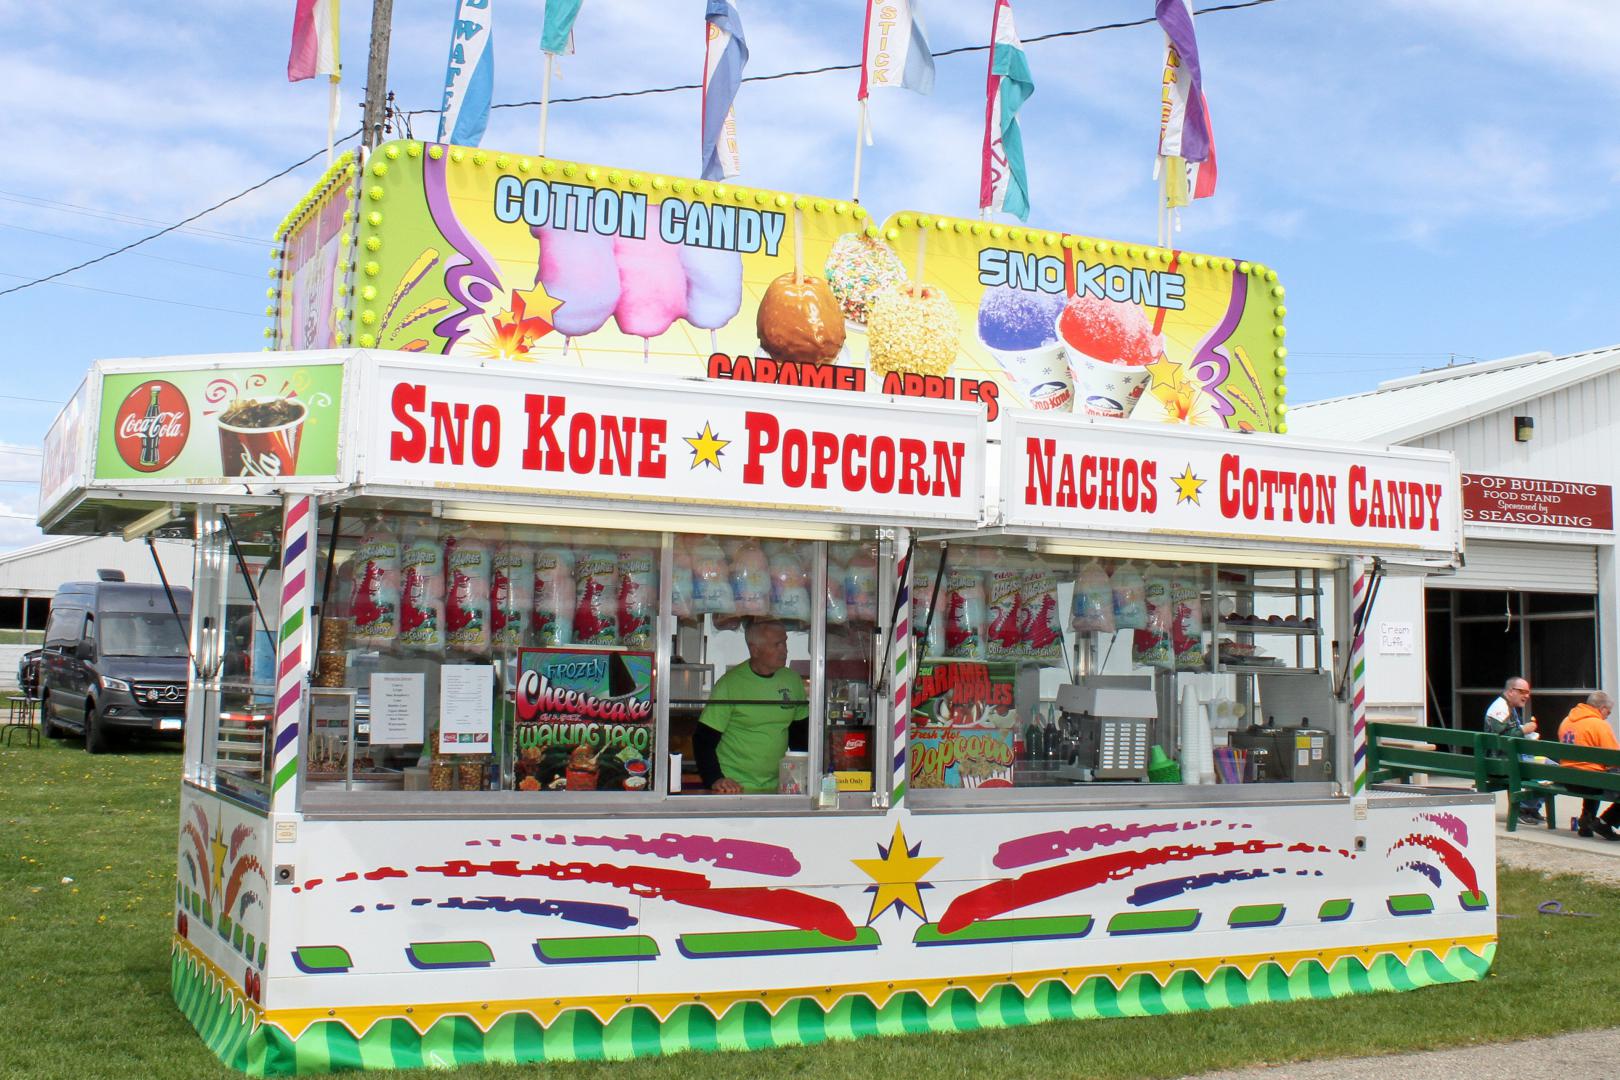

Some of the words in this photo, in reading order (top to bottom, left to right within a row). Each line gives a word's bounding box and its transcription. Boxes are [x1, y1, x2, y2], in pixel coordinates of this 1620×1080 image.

[494, 175, 648, 240] COTTON
[659, 198, 786, 257] CANDY
[978, 248, 1066, 294] SNO
[1076, 263, 1186, 310] KONE
[1483, 490, 1518, 500] FOOD
[1520, 493, 1561, 504] STAND
[1510, 479, 1598, 497] BUILDING
[1497, 499, 1537, 511] Sponsored
[1538, 503, 1549, 514] by
[1479, 510, 1593, 527] SEASONING
[1380, 623, 1410, 634] Cream
[547, 658, 607, 681] FROZEN
[517, 669, 652, 721] Cheesecake
[911, 662, 990, 708] CARAMEL
[952, 682, 1014, 705] APPLES
[519, 723, 600, 748] WALKING
[603, 724, 650, 751] TACO
[910, 735, 1015, 780] Popcorn
